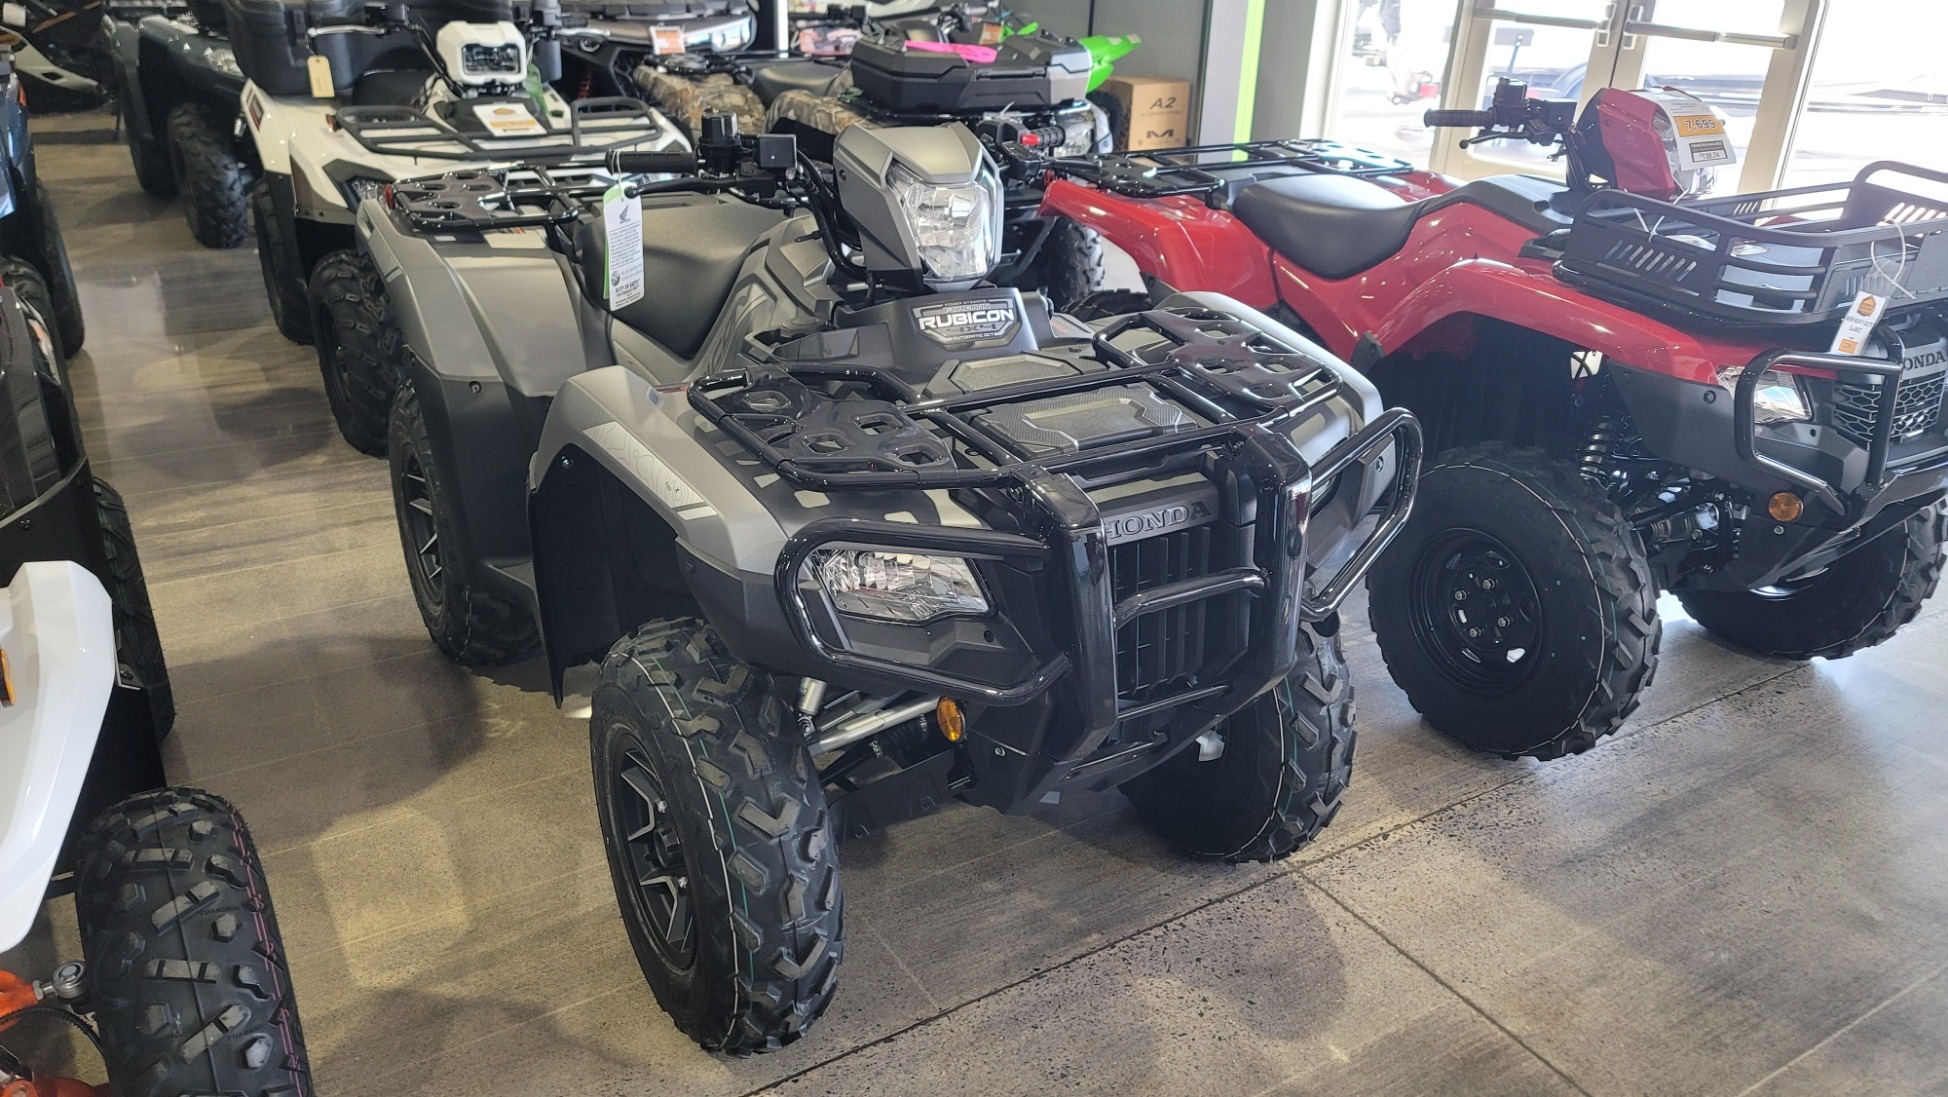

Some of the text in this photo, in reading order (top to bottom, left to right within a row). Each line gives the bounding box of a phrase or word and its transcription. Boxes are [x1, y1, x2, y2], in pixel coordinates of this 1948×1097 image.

[1149, 97, 1177, 109] A2
[1685, 119, 1716, 131] 7,699
[919, 309, 1015, 330] RUBICON
[1902, 351, 1946, 371] ONDA
